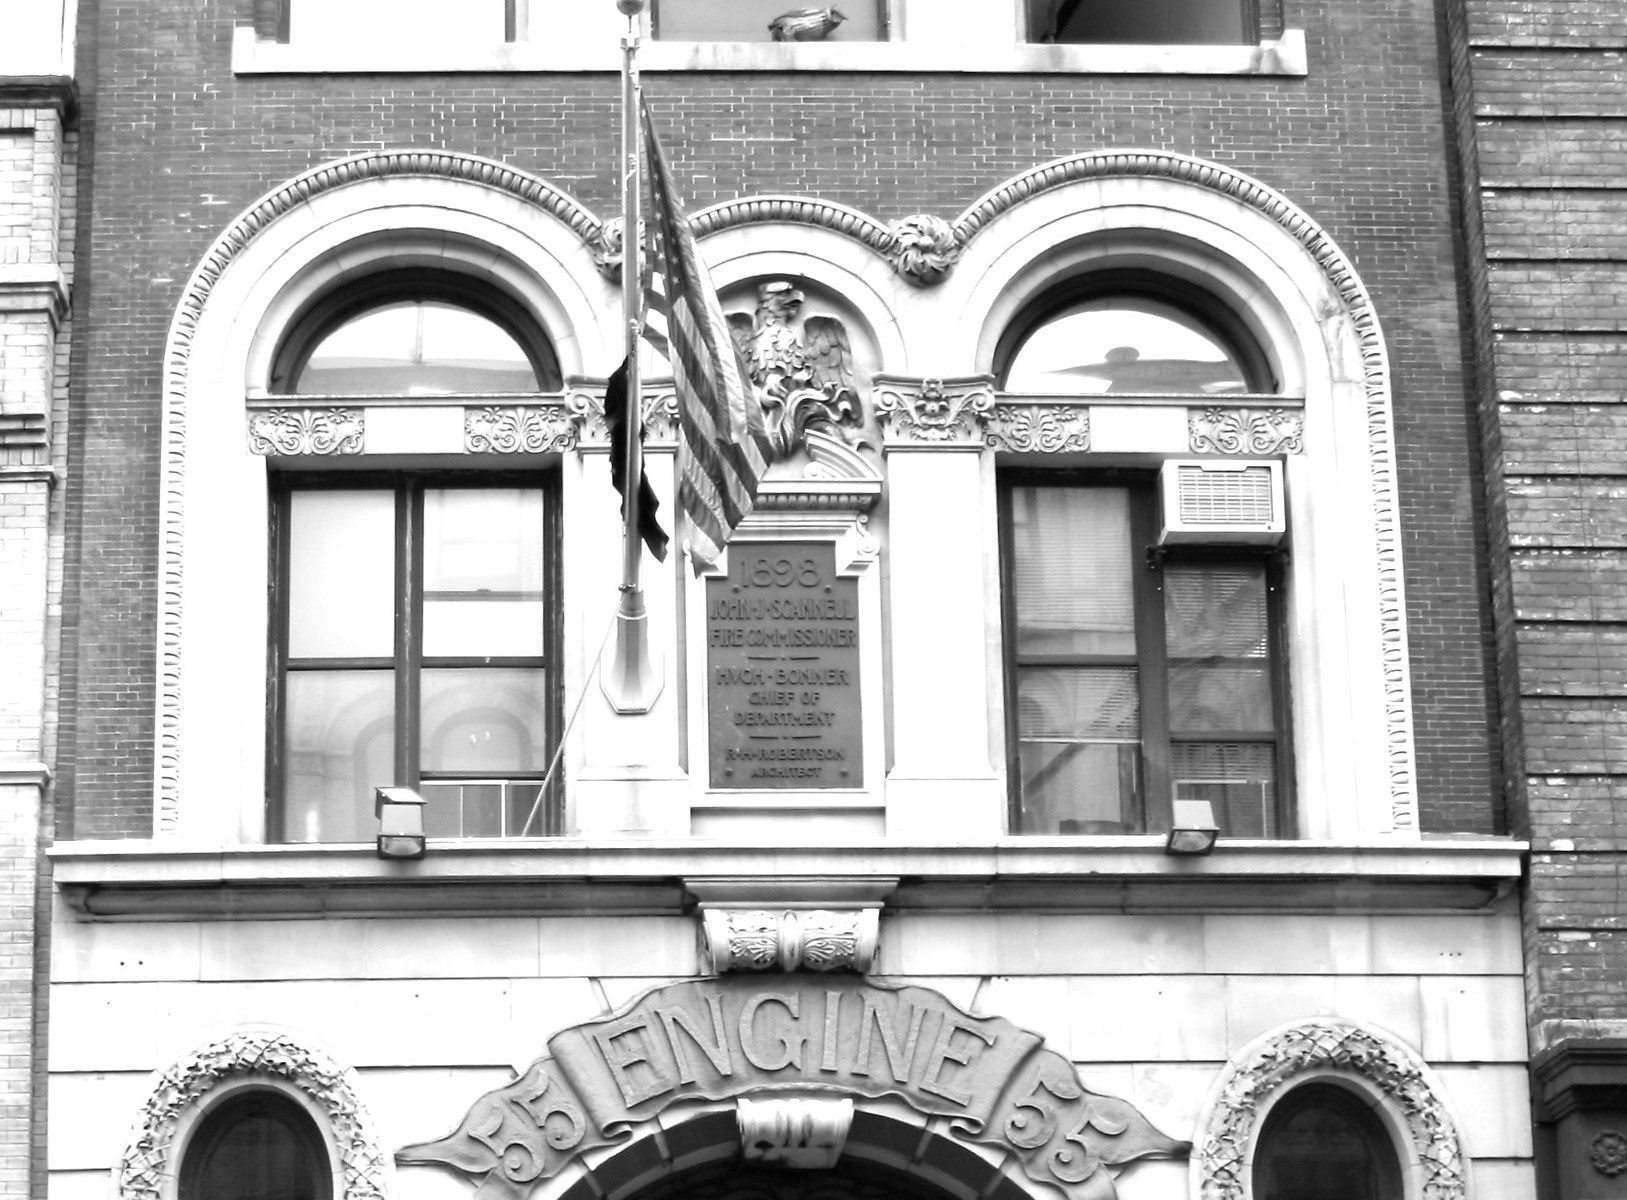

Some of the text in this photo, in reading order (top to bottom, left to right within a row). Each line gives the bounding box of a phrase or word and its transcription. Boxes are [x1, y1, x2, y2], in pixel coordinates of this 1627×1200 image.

[741, 559, 821, 588] 1898
[710, 628, 857, 648] FIRE COMMISSIONER
[774, 668, 850, 686] BONNER
[748, 691, 820, 706] CHIEF OF
[734, 711, 836, 726] DEPARTMENT
[468, 990, 1129, 1184] 55 ENGINE 55
